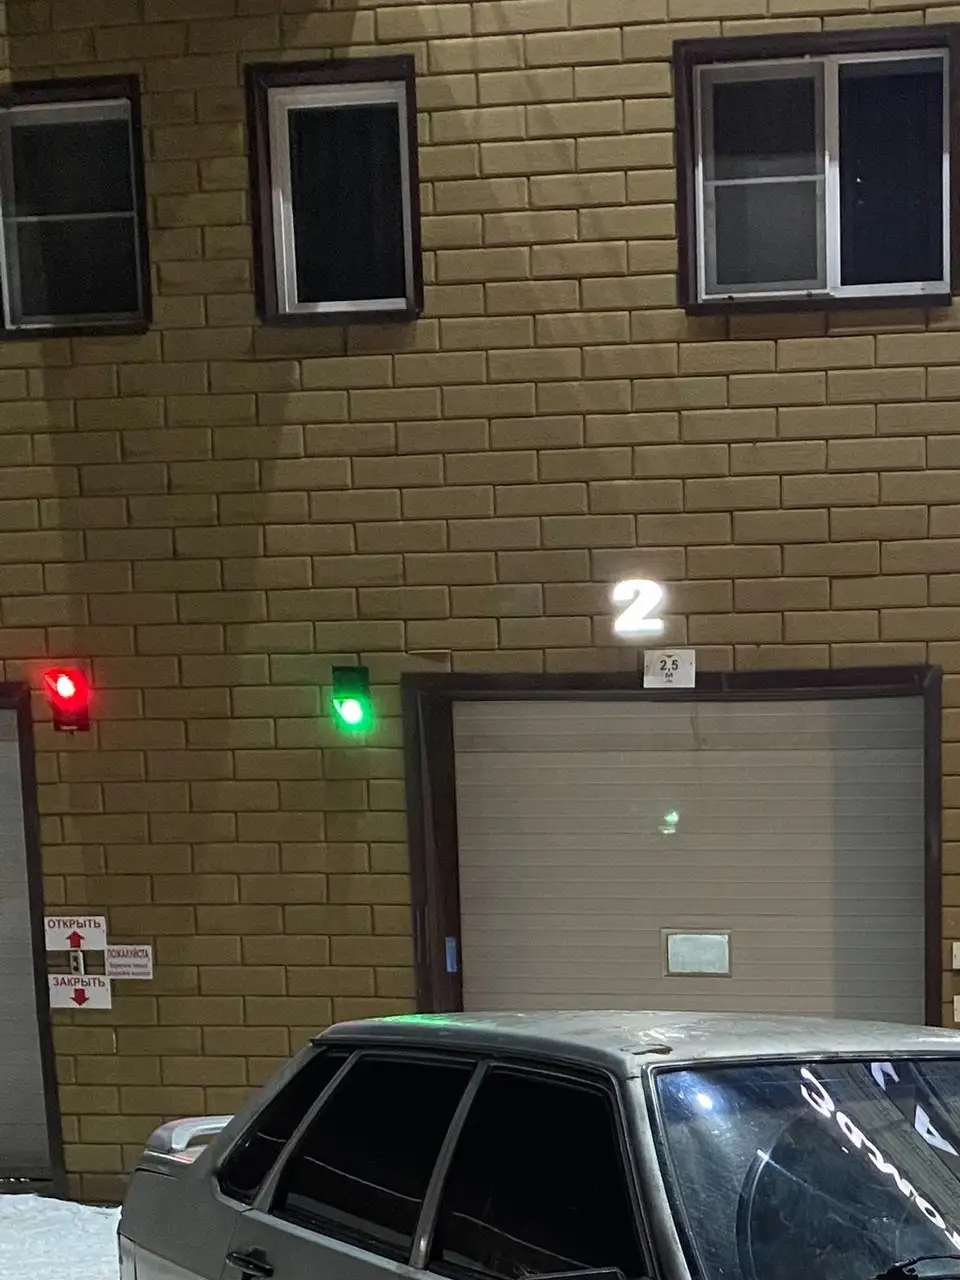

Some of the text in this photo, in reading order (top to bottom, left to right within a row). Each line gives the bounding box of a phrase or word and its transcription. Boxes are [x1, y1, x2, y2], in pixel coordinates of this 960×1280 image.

[613, 579, 665, 634] 2
[659, 659, 679, 673] 2,5
[47, 918, 102, 929] ОТКРЫТЬ
[52, 976, 106, 987] ЗАКРЫТЬ
